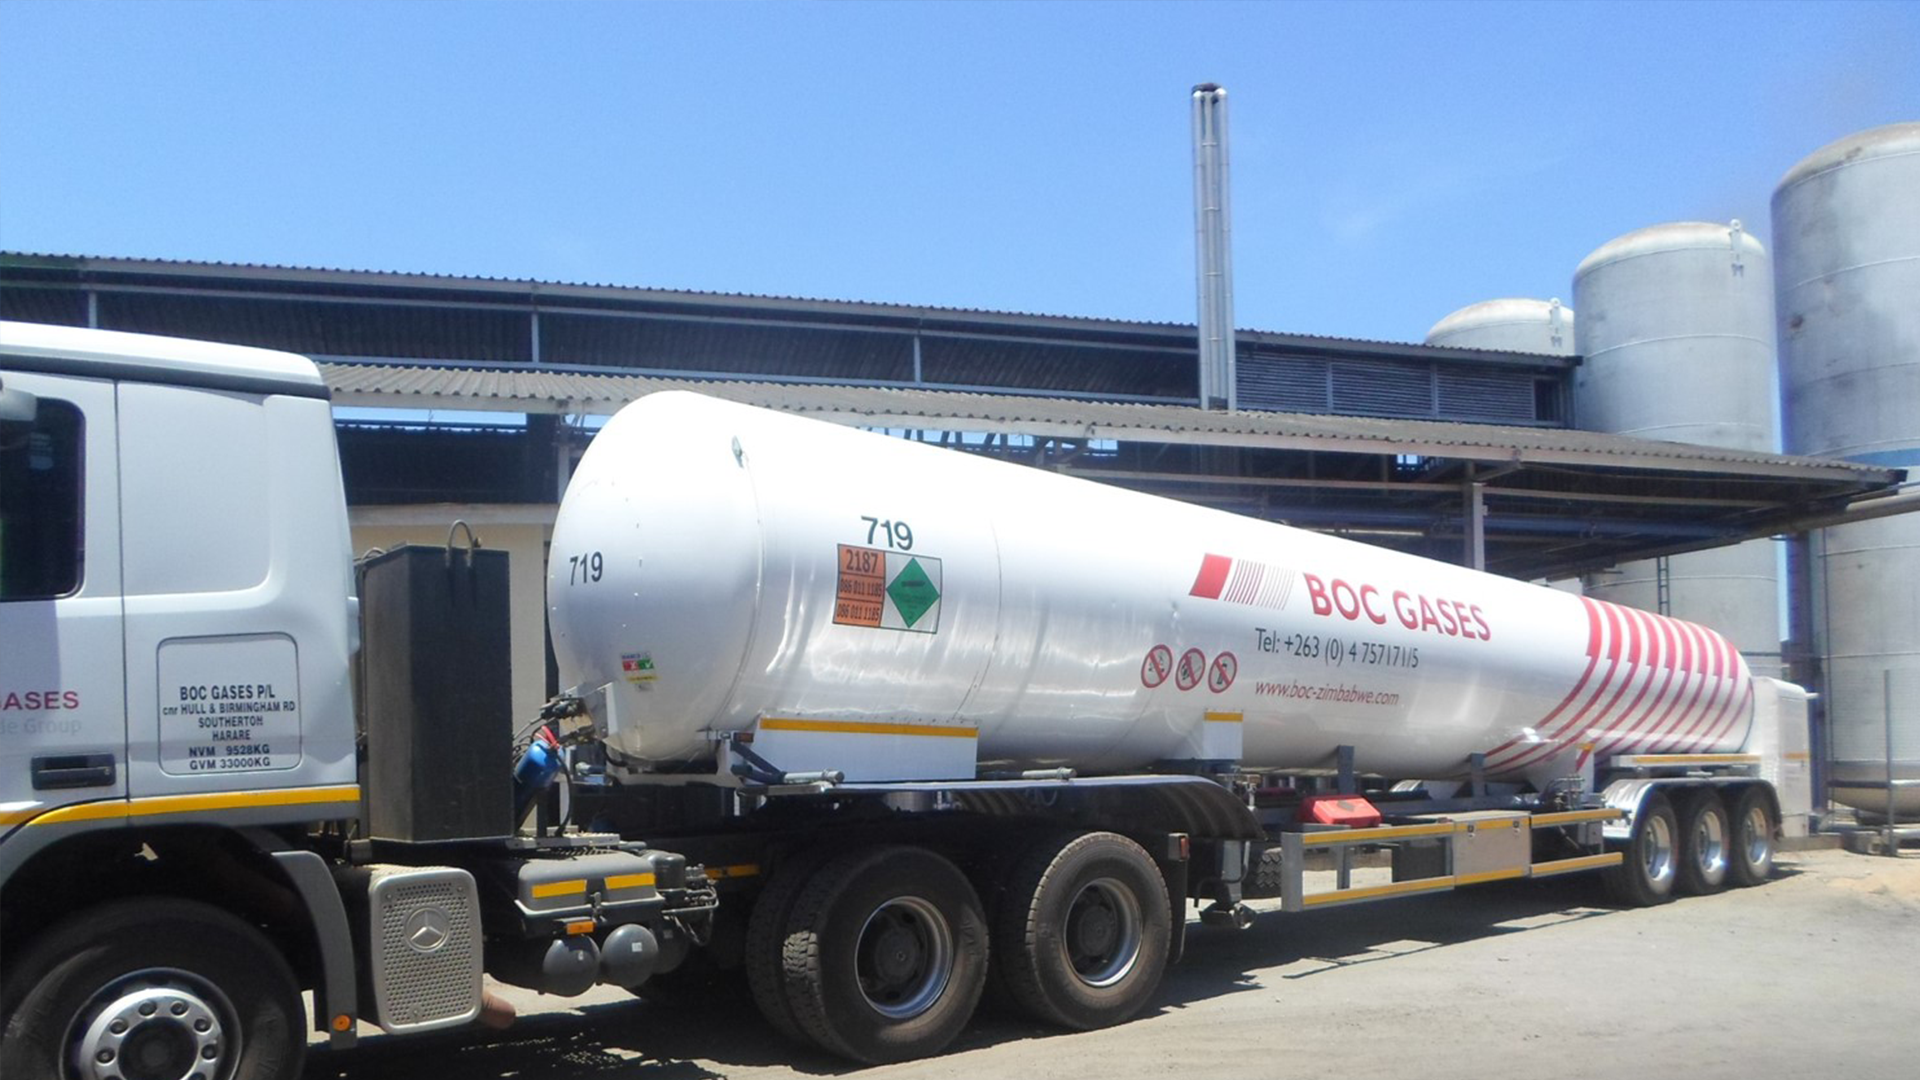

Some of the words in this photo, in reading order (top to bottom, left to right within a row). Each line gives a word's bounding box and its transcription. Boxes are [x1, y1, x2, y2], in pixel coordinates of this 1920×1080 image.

[861, 515, 913, 551] 719
[570, 551, 603, 586] 719
[845, 549, 878, 573] 2187
[1303, 572, 1387, 625] BOC
[1392, 590, 1491, 642] GASES
[1255, 628, 1280, 654] Tel:
[1284, 633, 1320, 658] +263
[1325, 638, 1344, 667] (0)
[1349, 640, 1357, 662] 4
[0, 691, 79, 710] ASES
[180, 686, 207, 701] BOC
[211, 684, 254, 700] GASES
[257, 684, 275, 699] P/L
[1255, 679, 1399, 706] www.boc-zimbabwe.com
[163, 706, 178, 715] cnr
[181, 703, 206, 715] HULL
[209, 703, 216, 714] &
[219, 701, 280, 714] BIRMINGHAM
[283, 701, 296, 712] RD
[23, 718, 82, 736] Group
[198, 716, 263, 728] SOUTHERTON
[212, 729, 251, 741] HARARE
[189, 746, 216, 757] NVM
[226, 744, 270, 756] 9528KG
[189, 760, 216, 770] GVM
[220, 757, 271, 769] 33000KG
